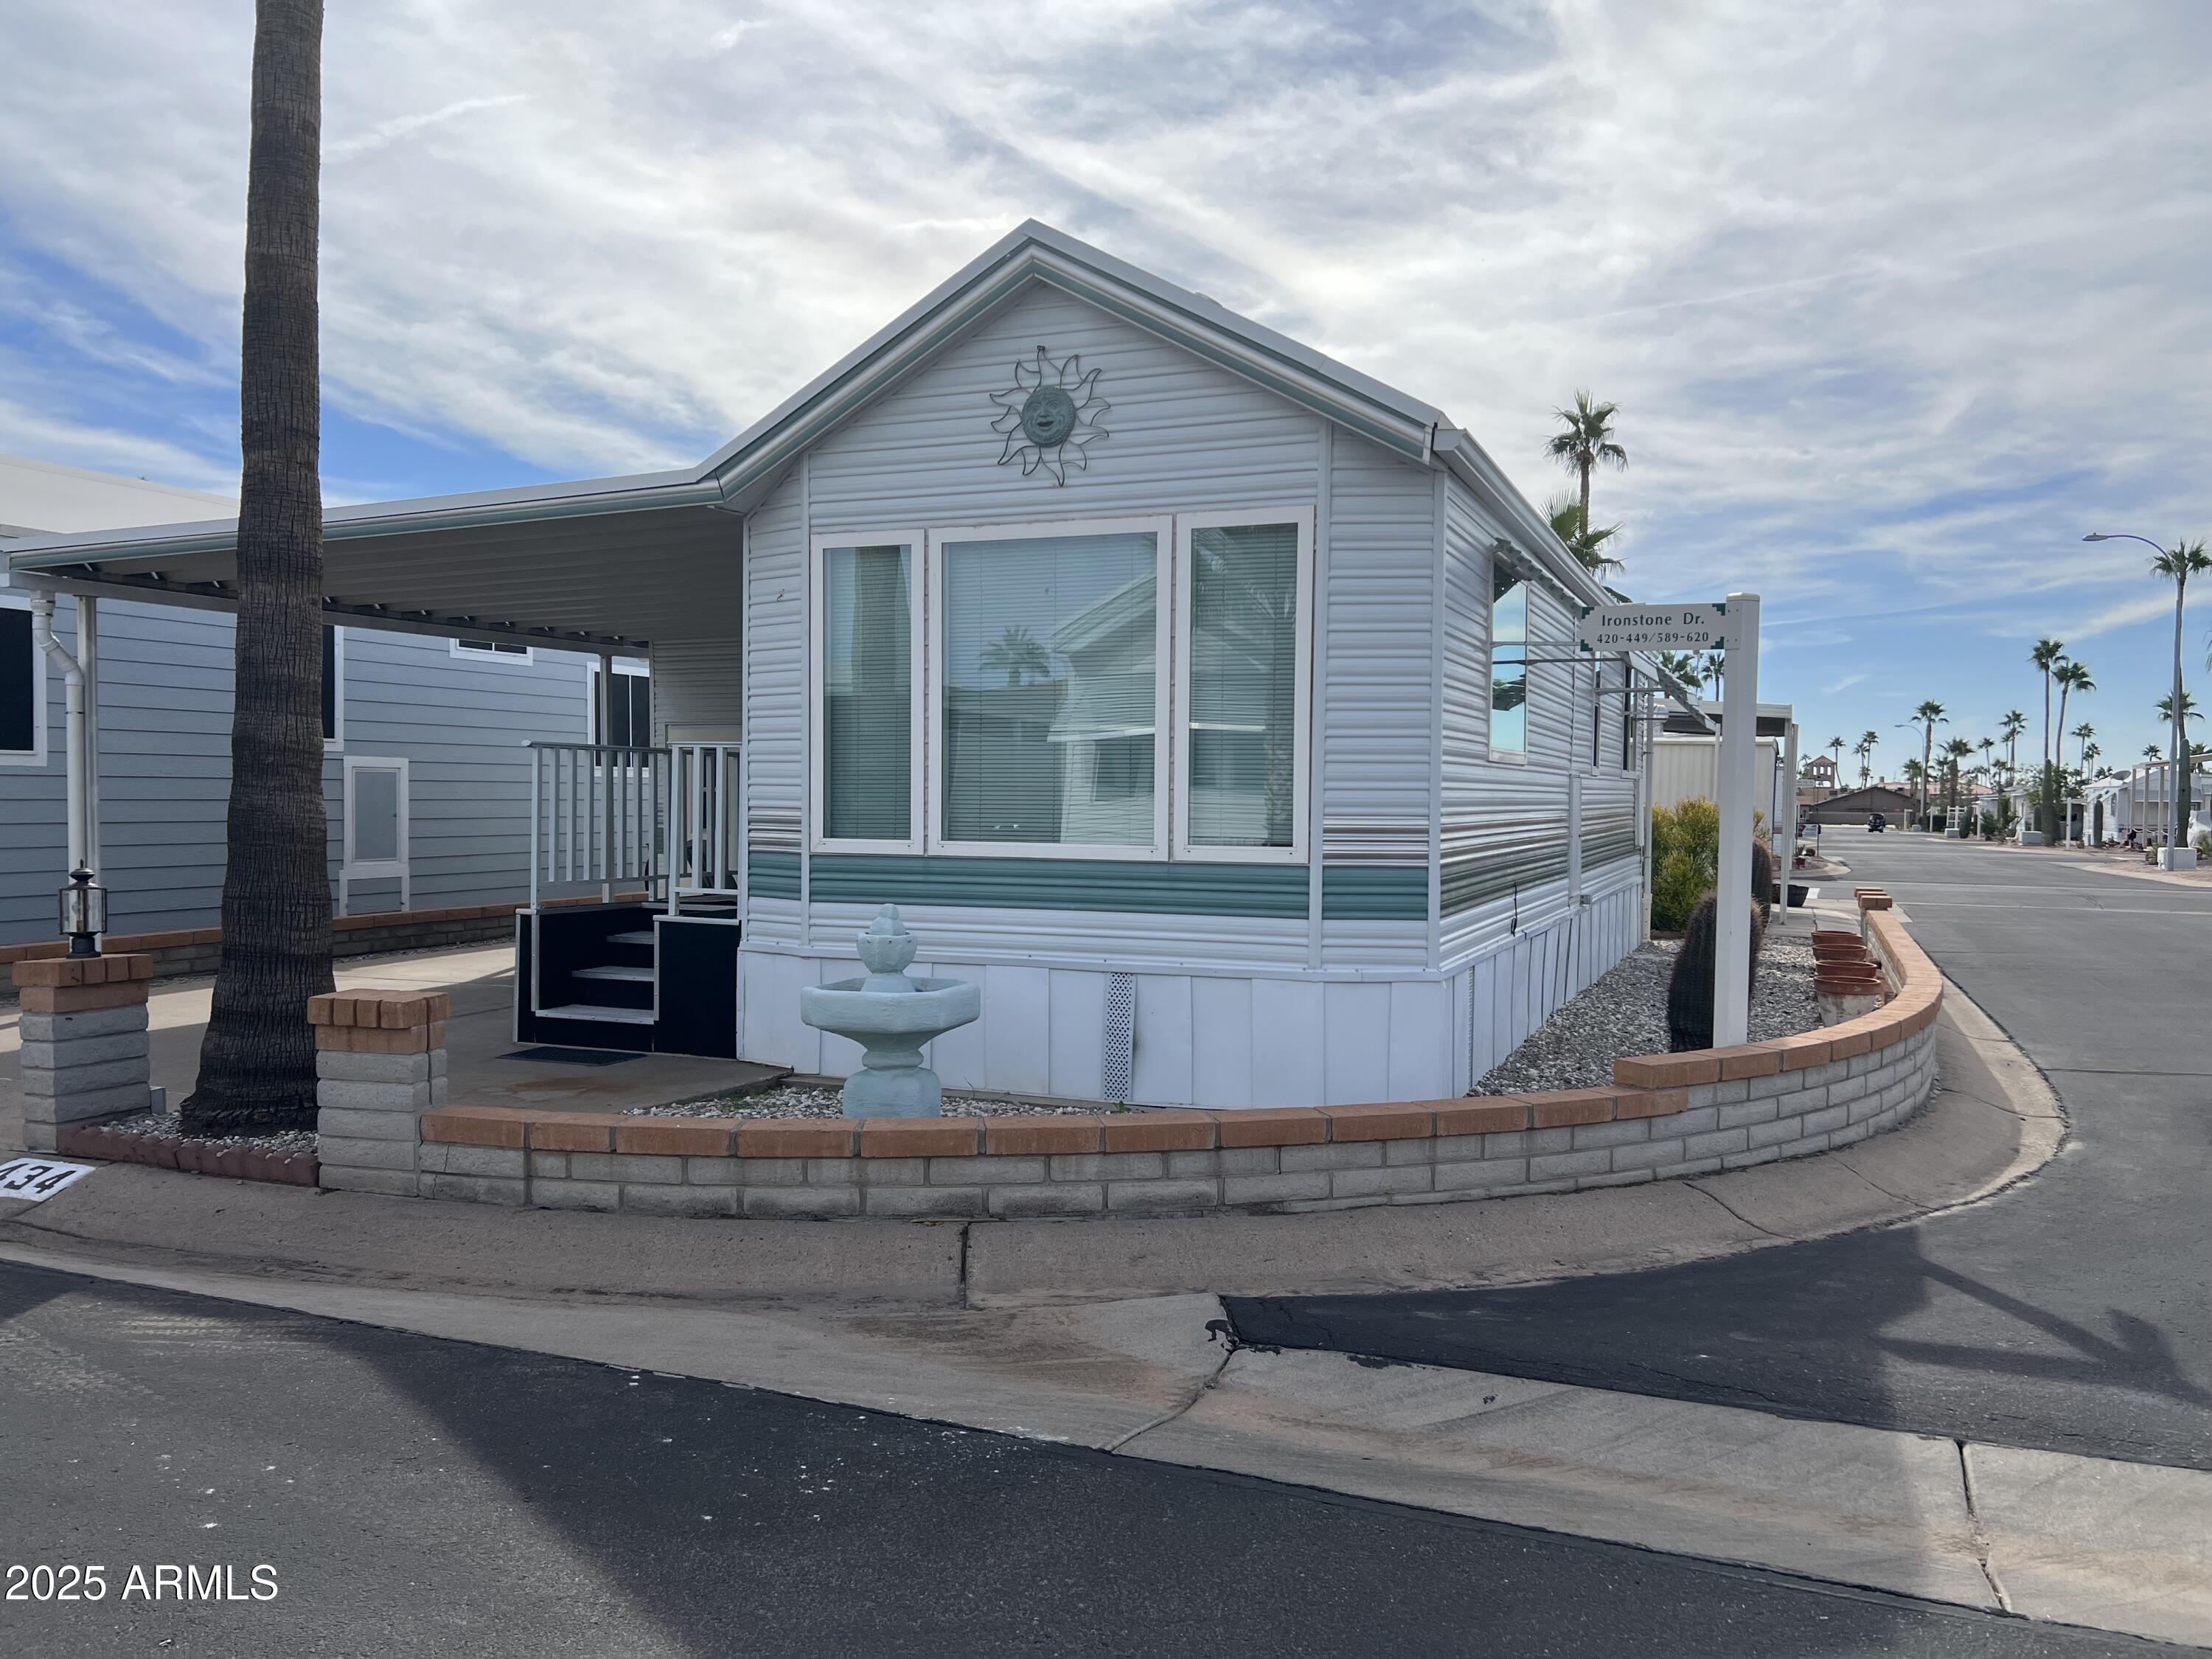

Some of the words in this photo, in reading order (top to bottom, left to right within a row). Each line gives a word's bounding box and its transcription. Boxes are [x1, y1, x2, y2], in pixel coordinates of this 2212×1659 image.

[1601, 613, 1672, 627] Ironstone
[1683, 612, 1705, 625] Dr.
[1596, 631, 1709, 644] 420-449/589-620
